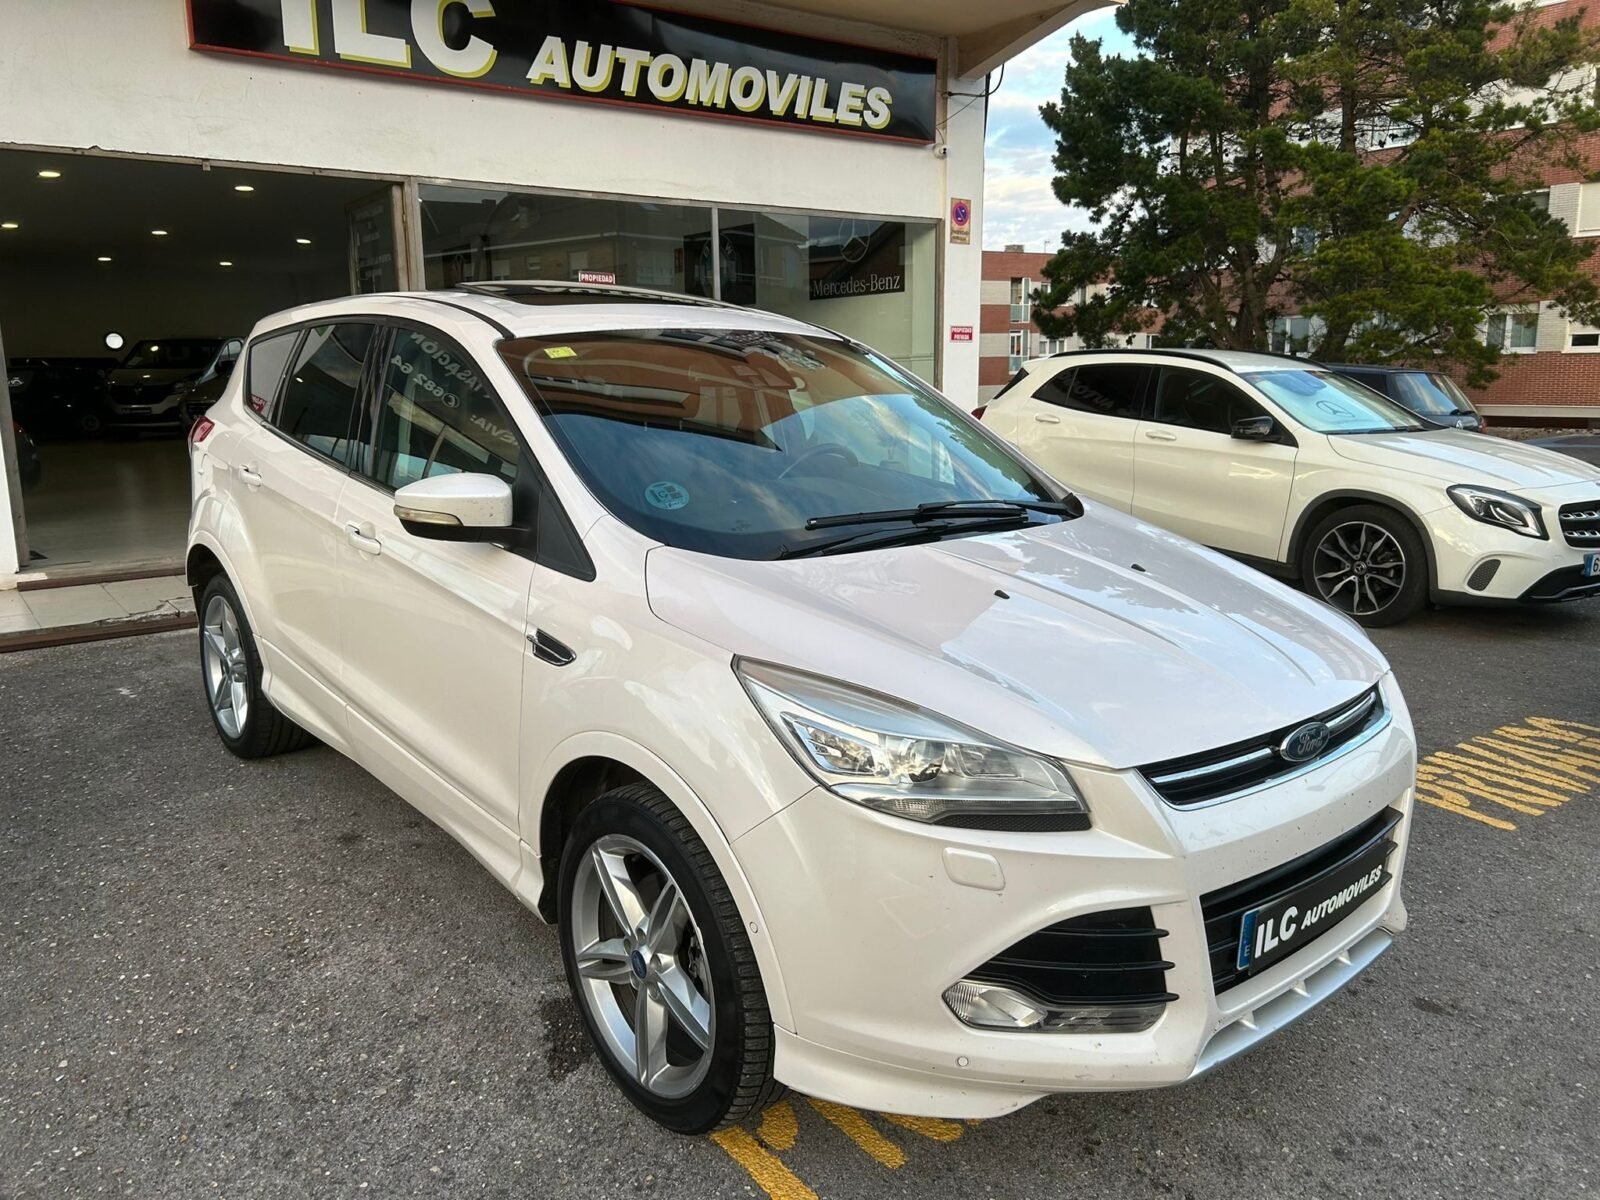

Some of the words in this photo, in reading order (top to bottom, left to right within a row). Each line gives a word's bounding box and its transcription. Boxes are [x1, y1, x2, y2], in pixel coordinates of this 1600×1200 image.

[525, 35, 893, 130] AUTOMOVILES
[581, 273, 613, 283] PROPIEDAD
[812, 273, 900, 297] Mercedes-Benz
[1297, 728, 1323, 755] Ford
[1254, 905, 1298, 959] ILC
[1301, 864, 1382, 930] AUTOMOVILES
